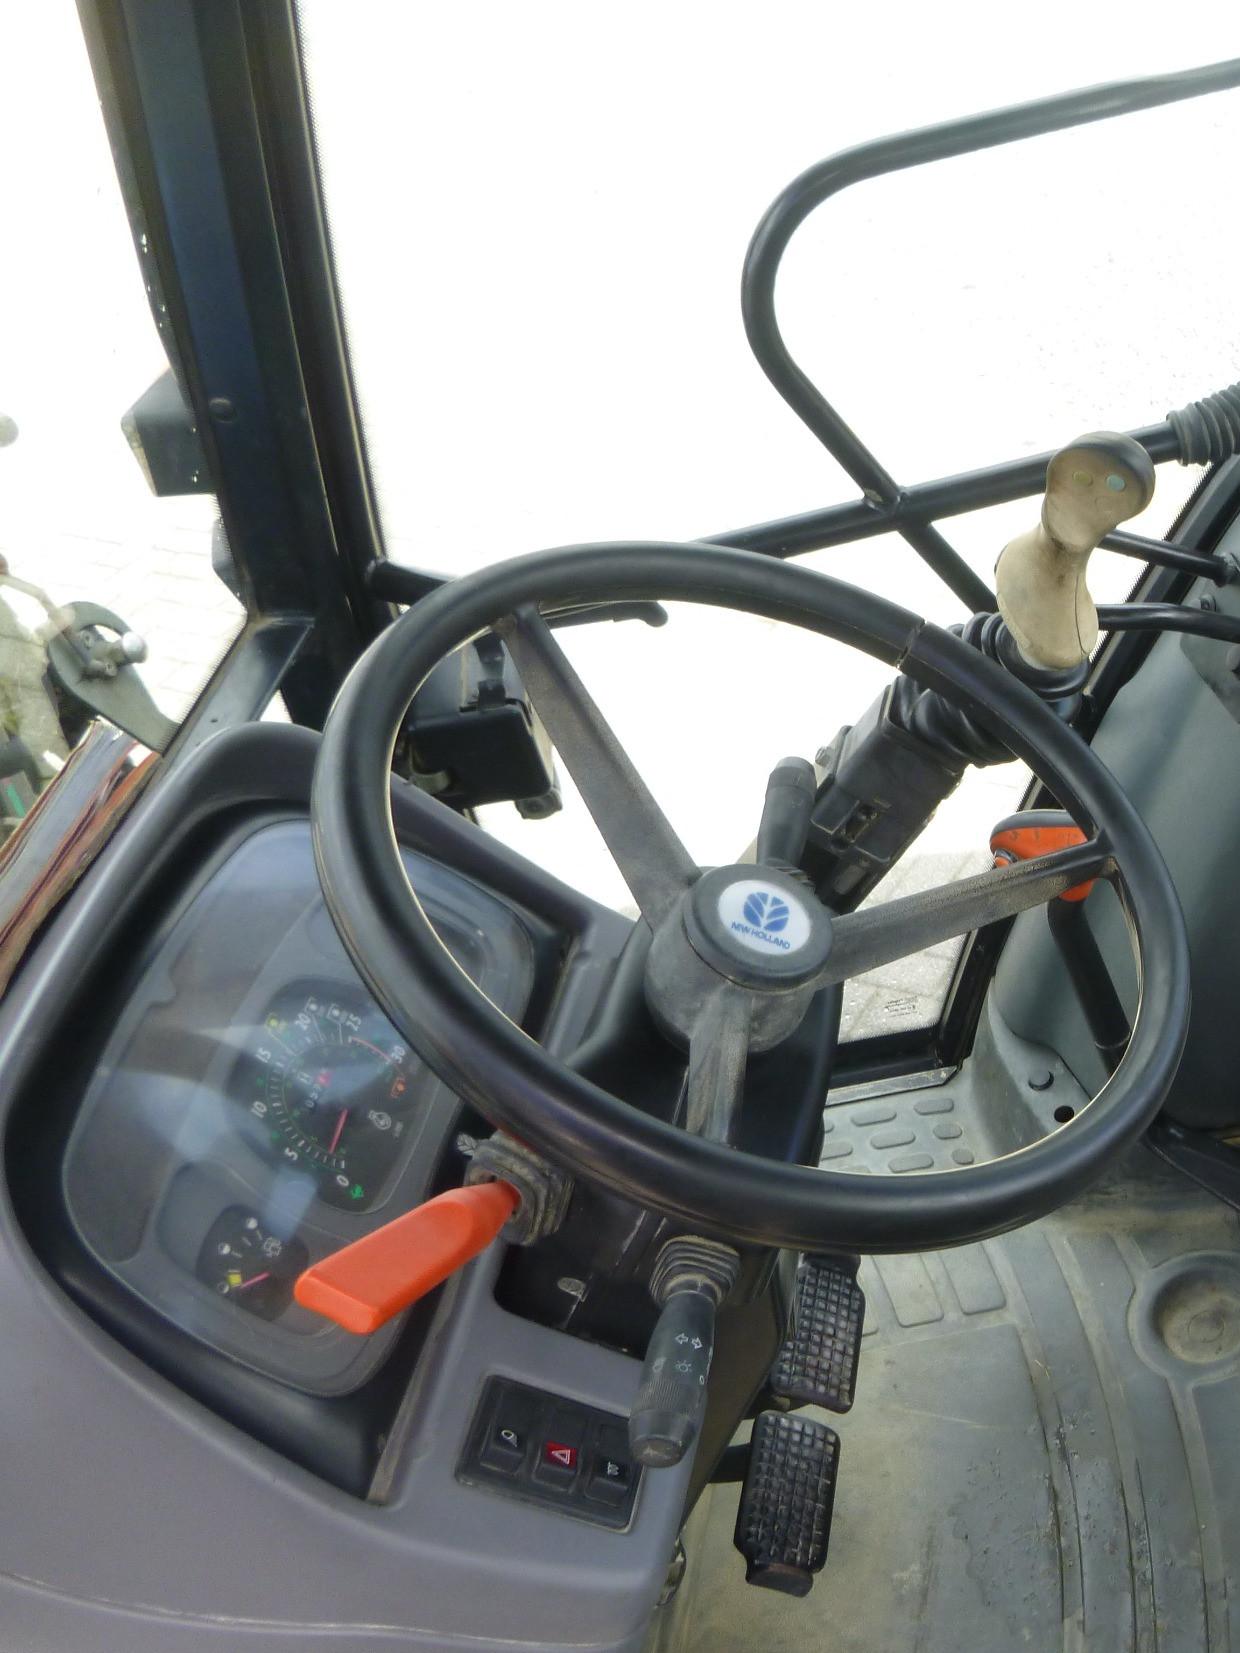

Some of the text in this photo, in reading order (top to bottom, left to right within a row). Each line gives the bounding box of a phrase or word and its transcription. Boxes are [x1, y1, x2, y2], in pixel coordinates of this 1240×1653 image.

[731, 922, 790, 949] NEW HOLLAND
[294, 1012, 311, 1031] 20
[345, 1013, 362, 1032] 25
[254, 1046, 272, 1064] 15
[390, 1044, 406, 1064] 30
[251, 1100, 268, 1119] 10
[284, 1147, 299, 1161] 5
[336, 1173, 350, 1188] 0
